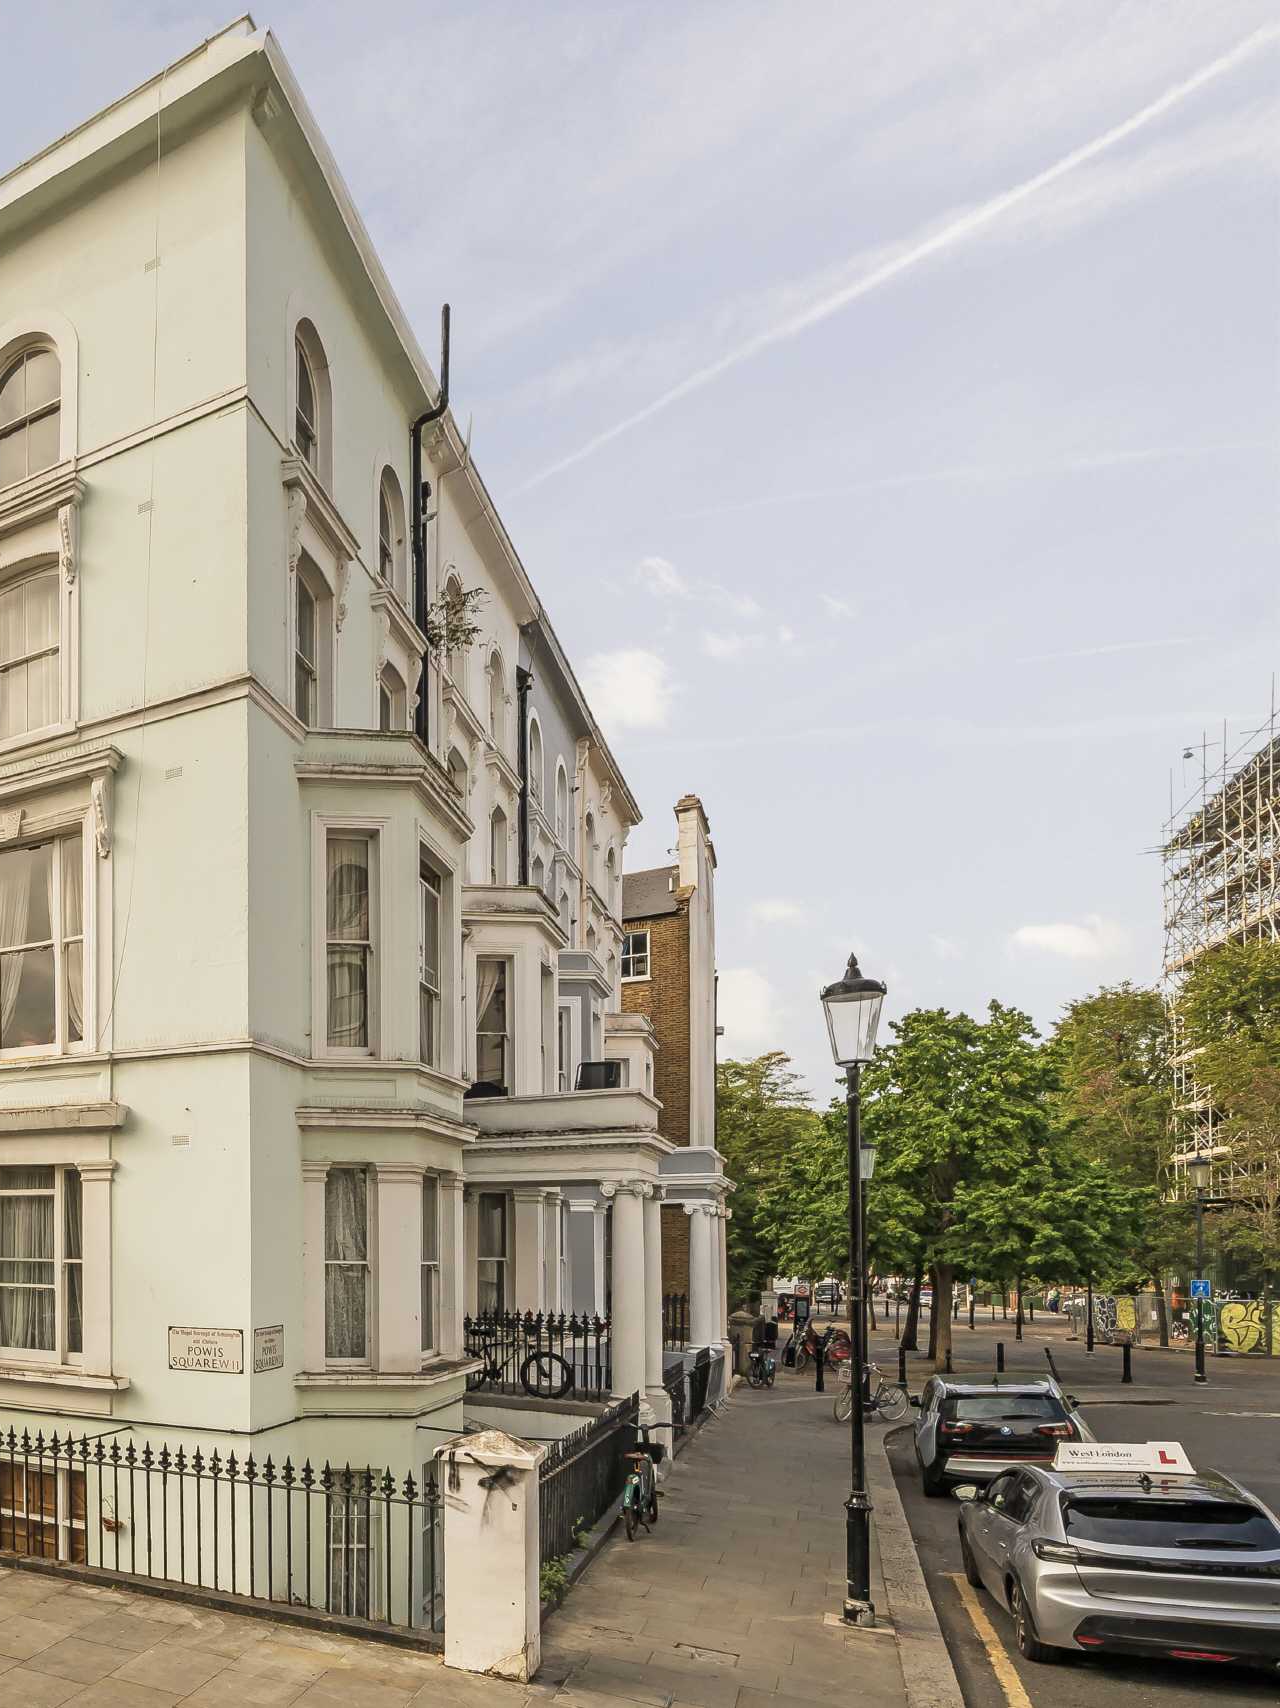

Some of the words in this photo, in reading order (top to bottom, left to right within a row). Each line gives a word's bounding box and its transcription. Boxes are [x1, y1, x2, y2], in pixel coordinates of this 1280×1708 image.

[187, 1346, 224, 1358] POWIS
[172, 1356, 218, 1369] SQUARE
[1096, 1450, 1132, 1458] London
[1158, 1451, 1177, 1464] L
